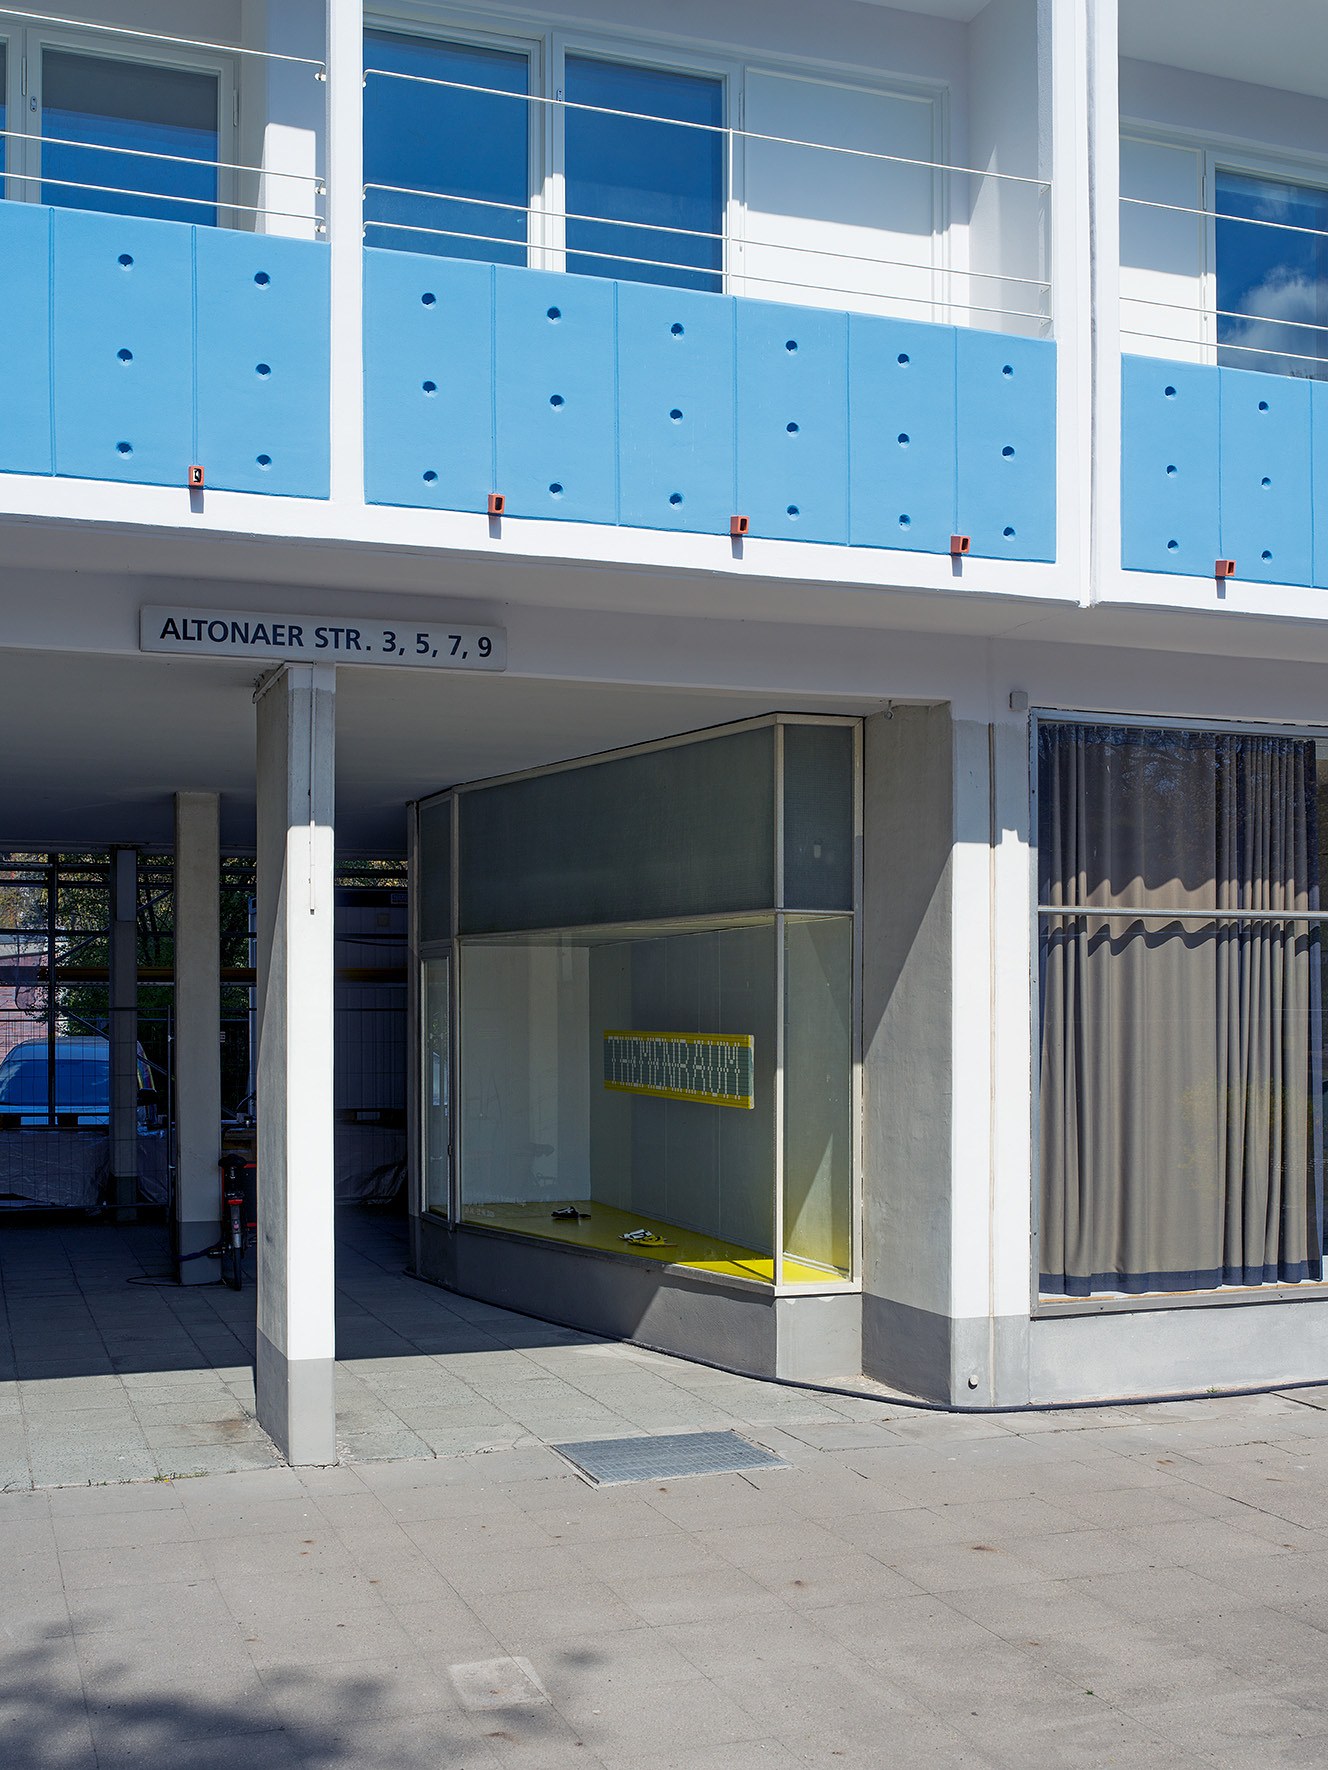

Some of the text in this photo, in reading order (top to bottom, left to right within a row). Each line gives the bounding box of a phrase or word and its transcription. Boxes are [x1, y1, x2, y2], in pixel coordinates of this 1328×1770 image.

[160, 618, 493, 660] ALTONAER STR. 3, 5, 7, 9
[608, 1036, 741, 1100] THEMENRAUM
